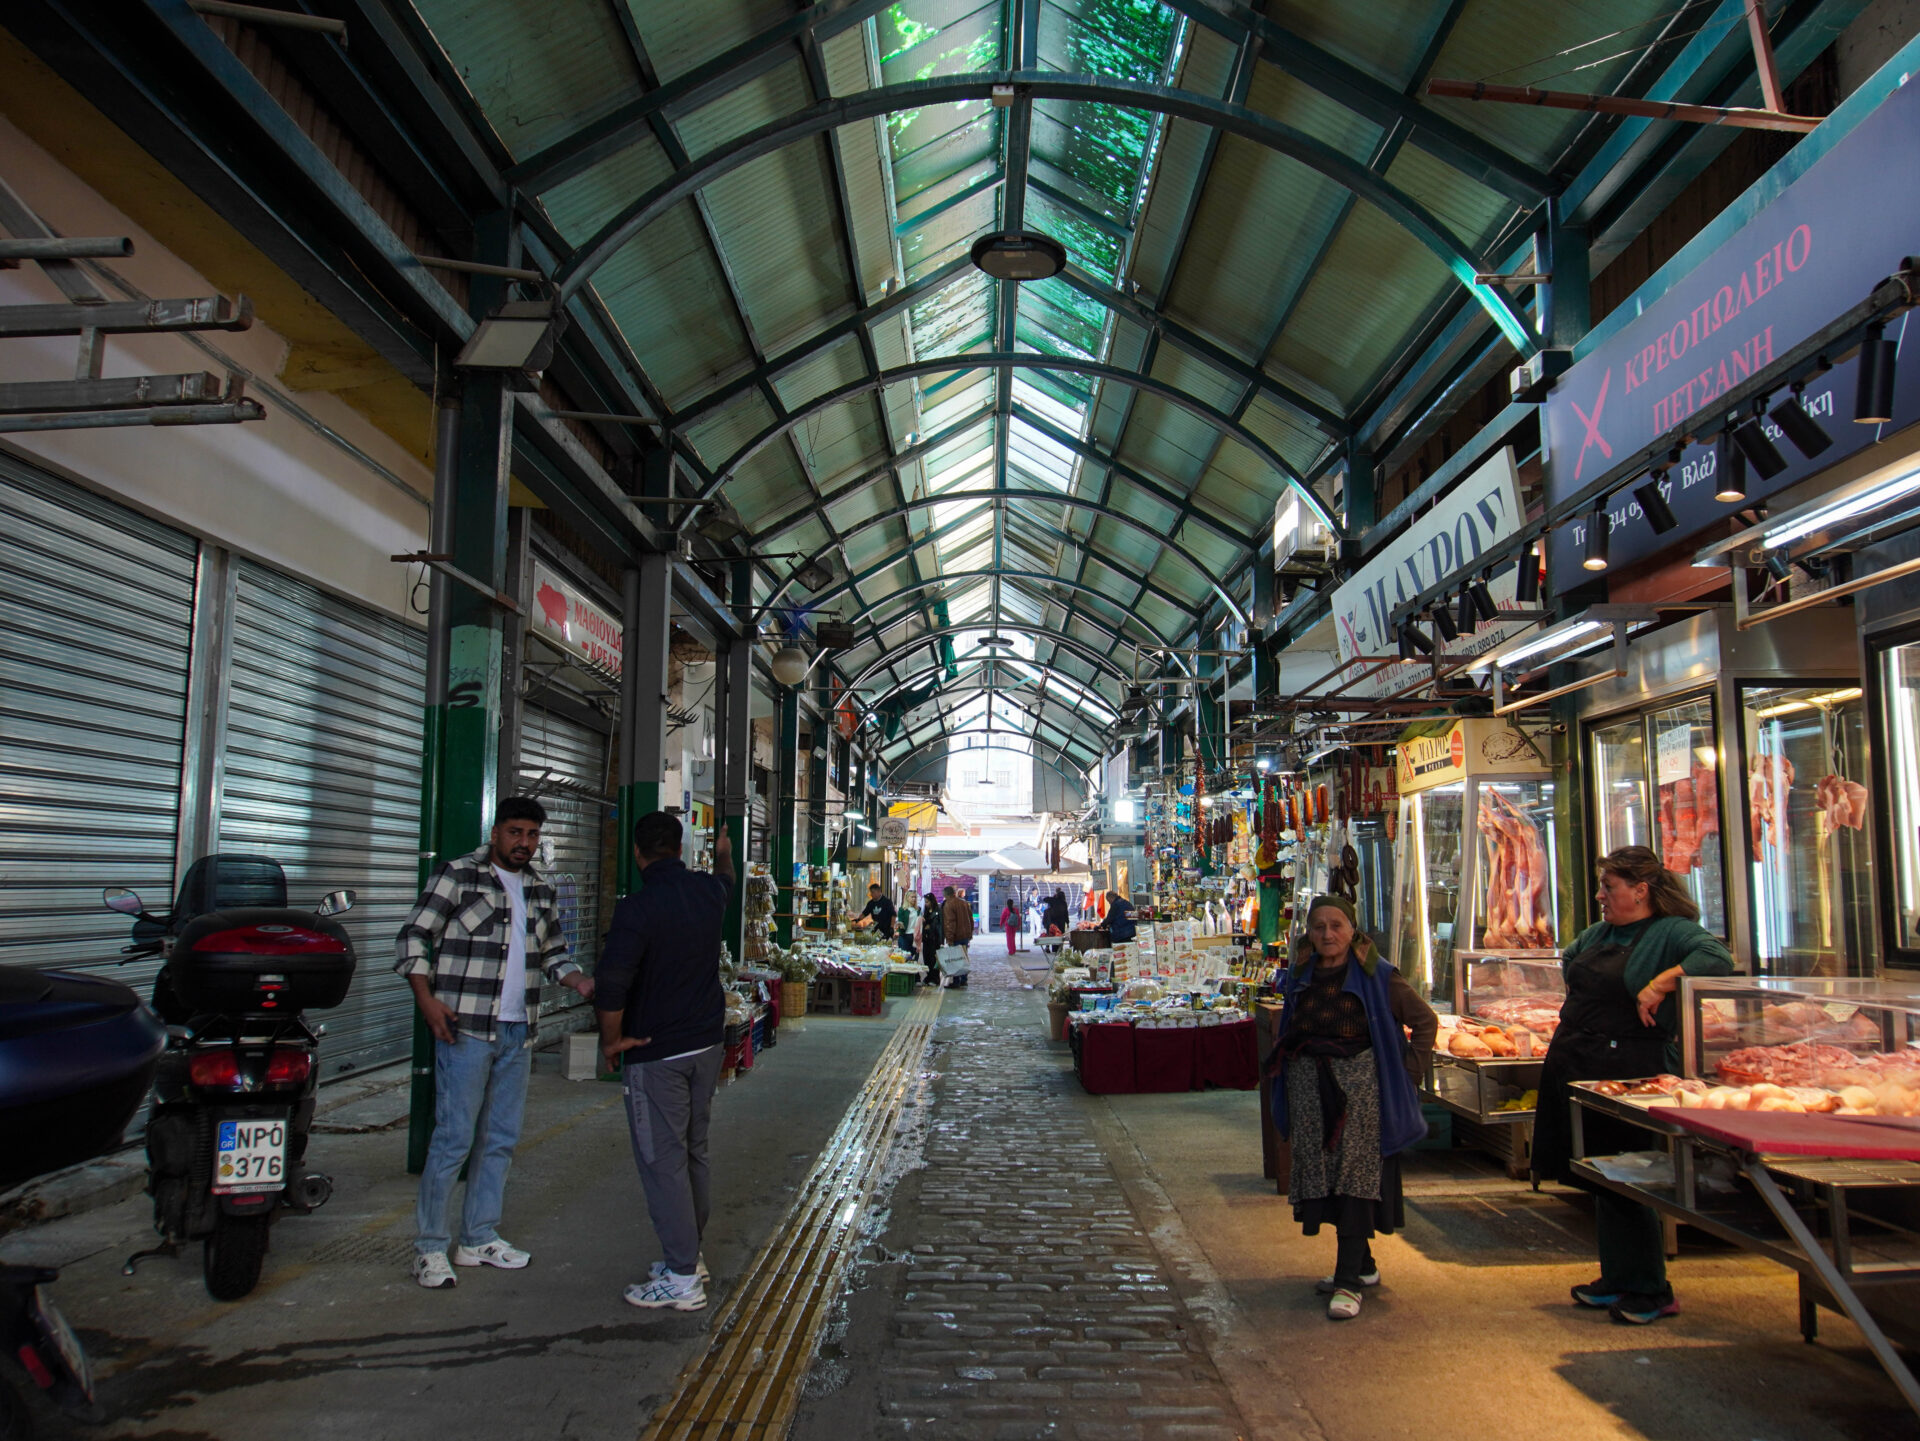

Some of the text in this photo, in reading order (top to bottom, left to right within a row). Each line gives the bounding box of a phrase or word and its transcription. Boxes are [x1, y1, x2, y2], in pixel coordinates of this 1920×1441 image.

[1625, 224, 1811, 395] ΚΡΕΟΠΩΛΕΙΟ
[1653, 325, 1775, 436] ΠΕΤΣΑΝΗ
[1681, 451, 1716, 490] Βλάλ
[221, 1140, 234, 1149] GR
[235, 1155, 282, 1178] 376
